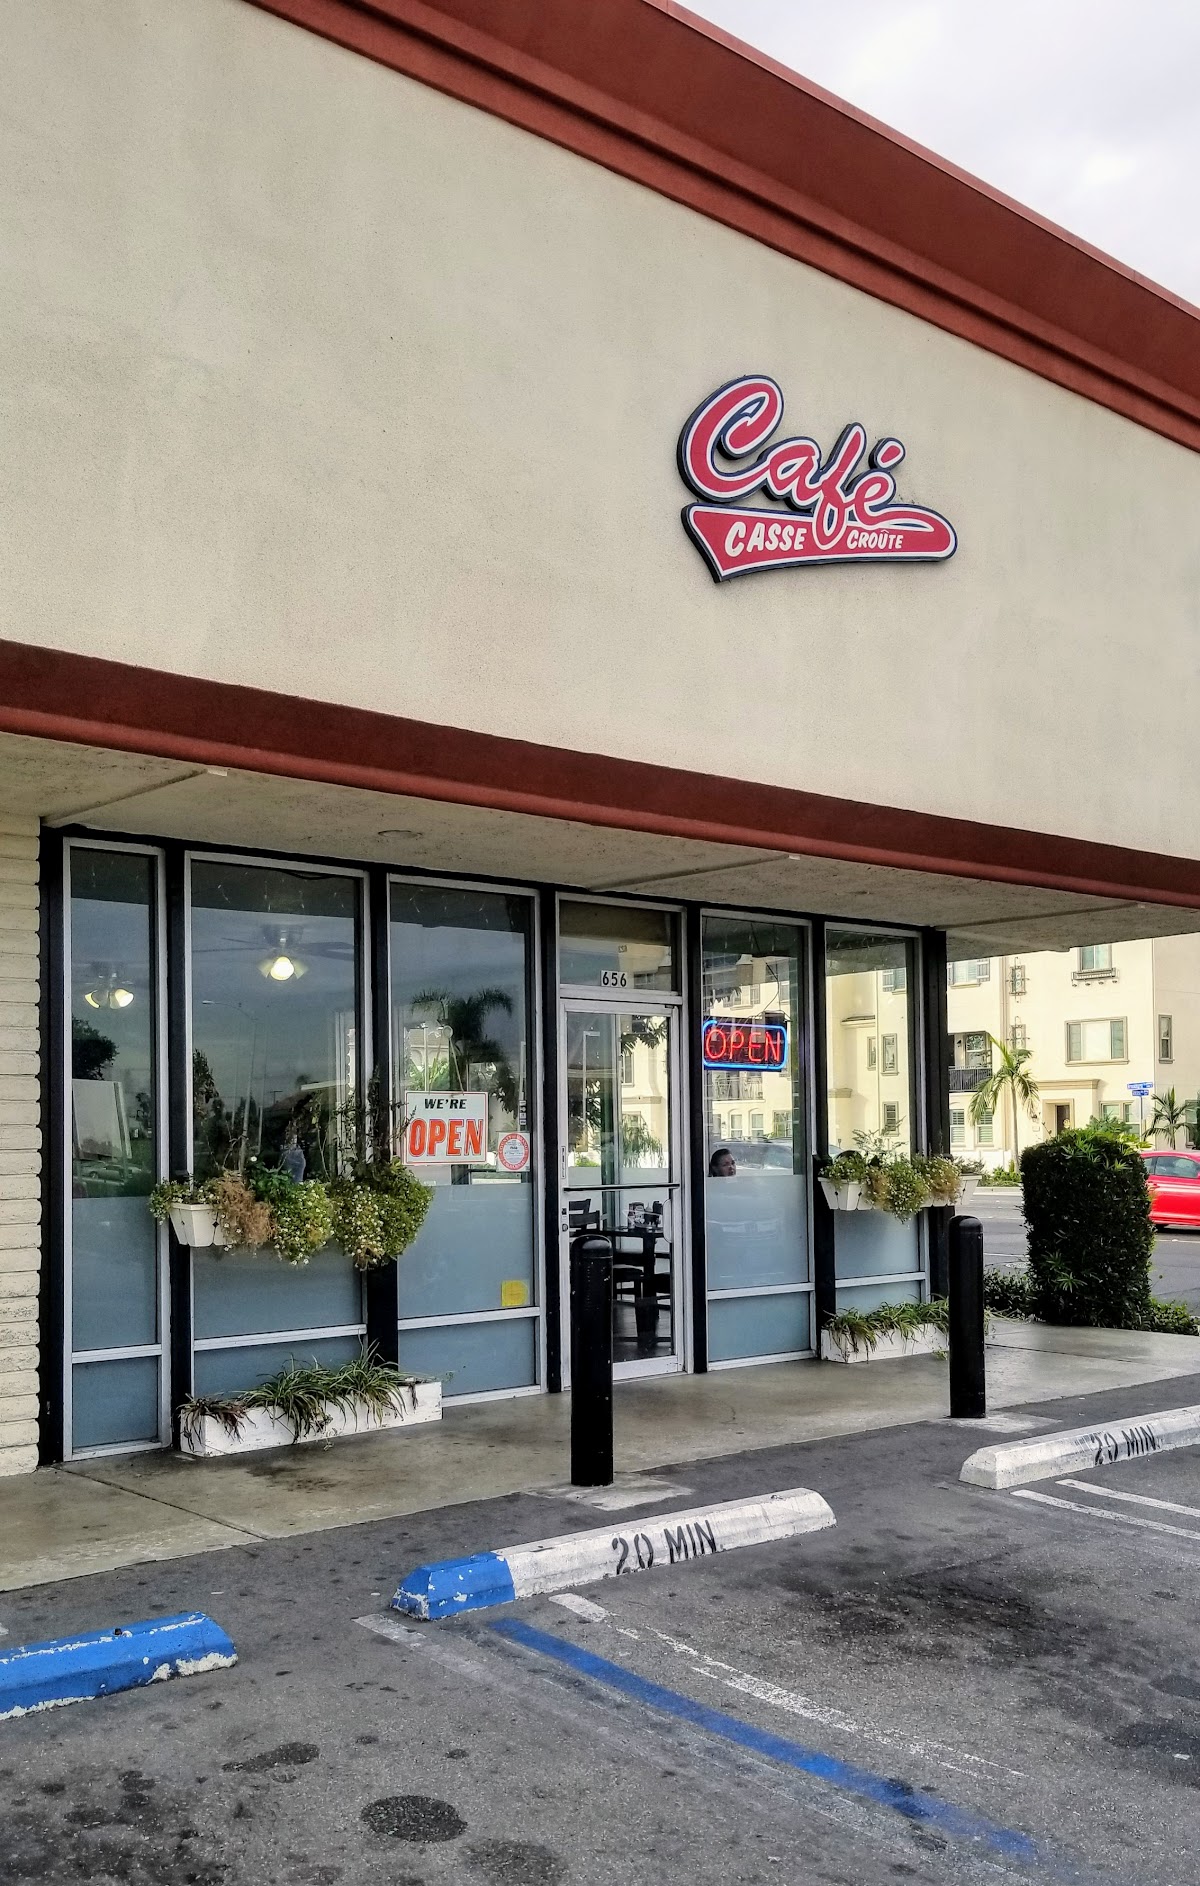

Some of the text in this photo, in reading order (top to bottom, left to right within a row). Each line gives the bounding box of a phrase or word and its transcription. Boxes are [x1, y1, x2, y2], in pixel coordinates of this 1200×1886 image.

[725, 521, 904, 557] CASSE CROÛTE
[602, 970, 628, 988] 656
[705, 1027, 781, 1063] OPEN
[424, 1098, 468, 1110] WE'RE
[409, 1118, 484, 1157] OPEN
[1089, 1424, 1156, 1465] 20 MIN
[612, 1520, 717, 1575] 20 MIN
